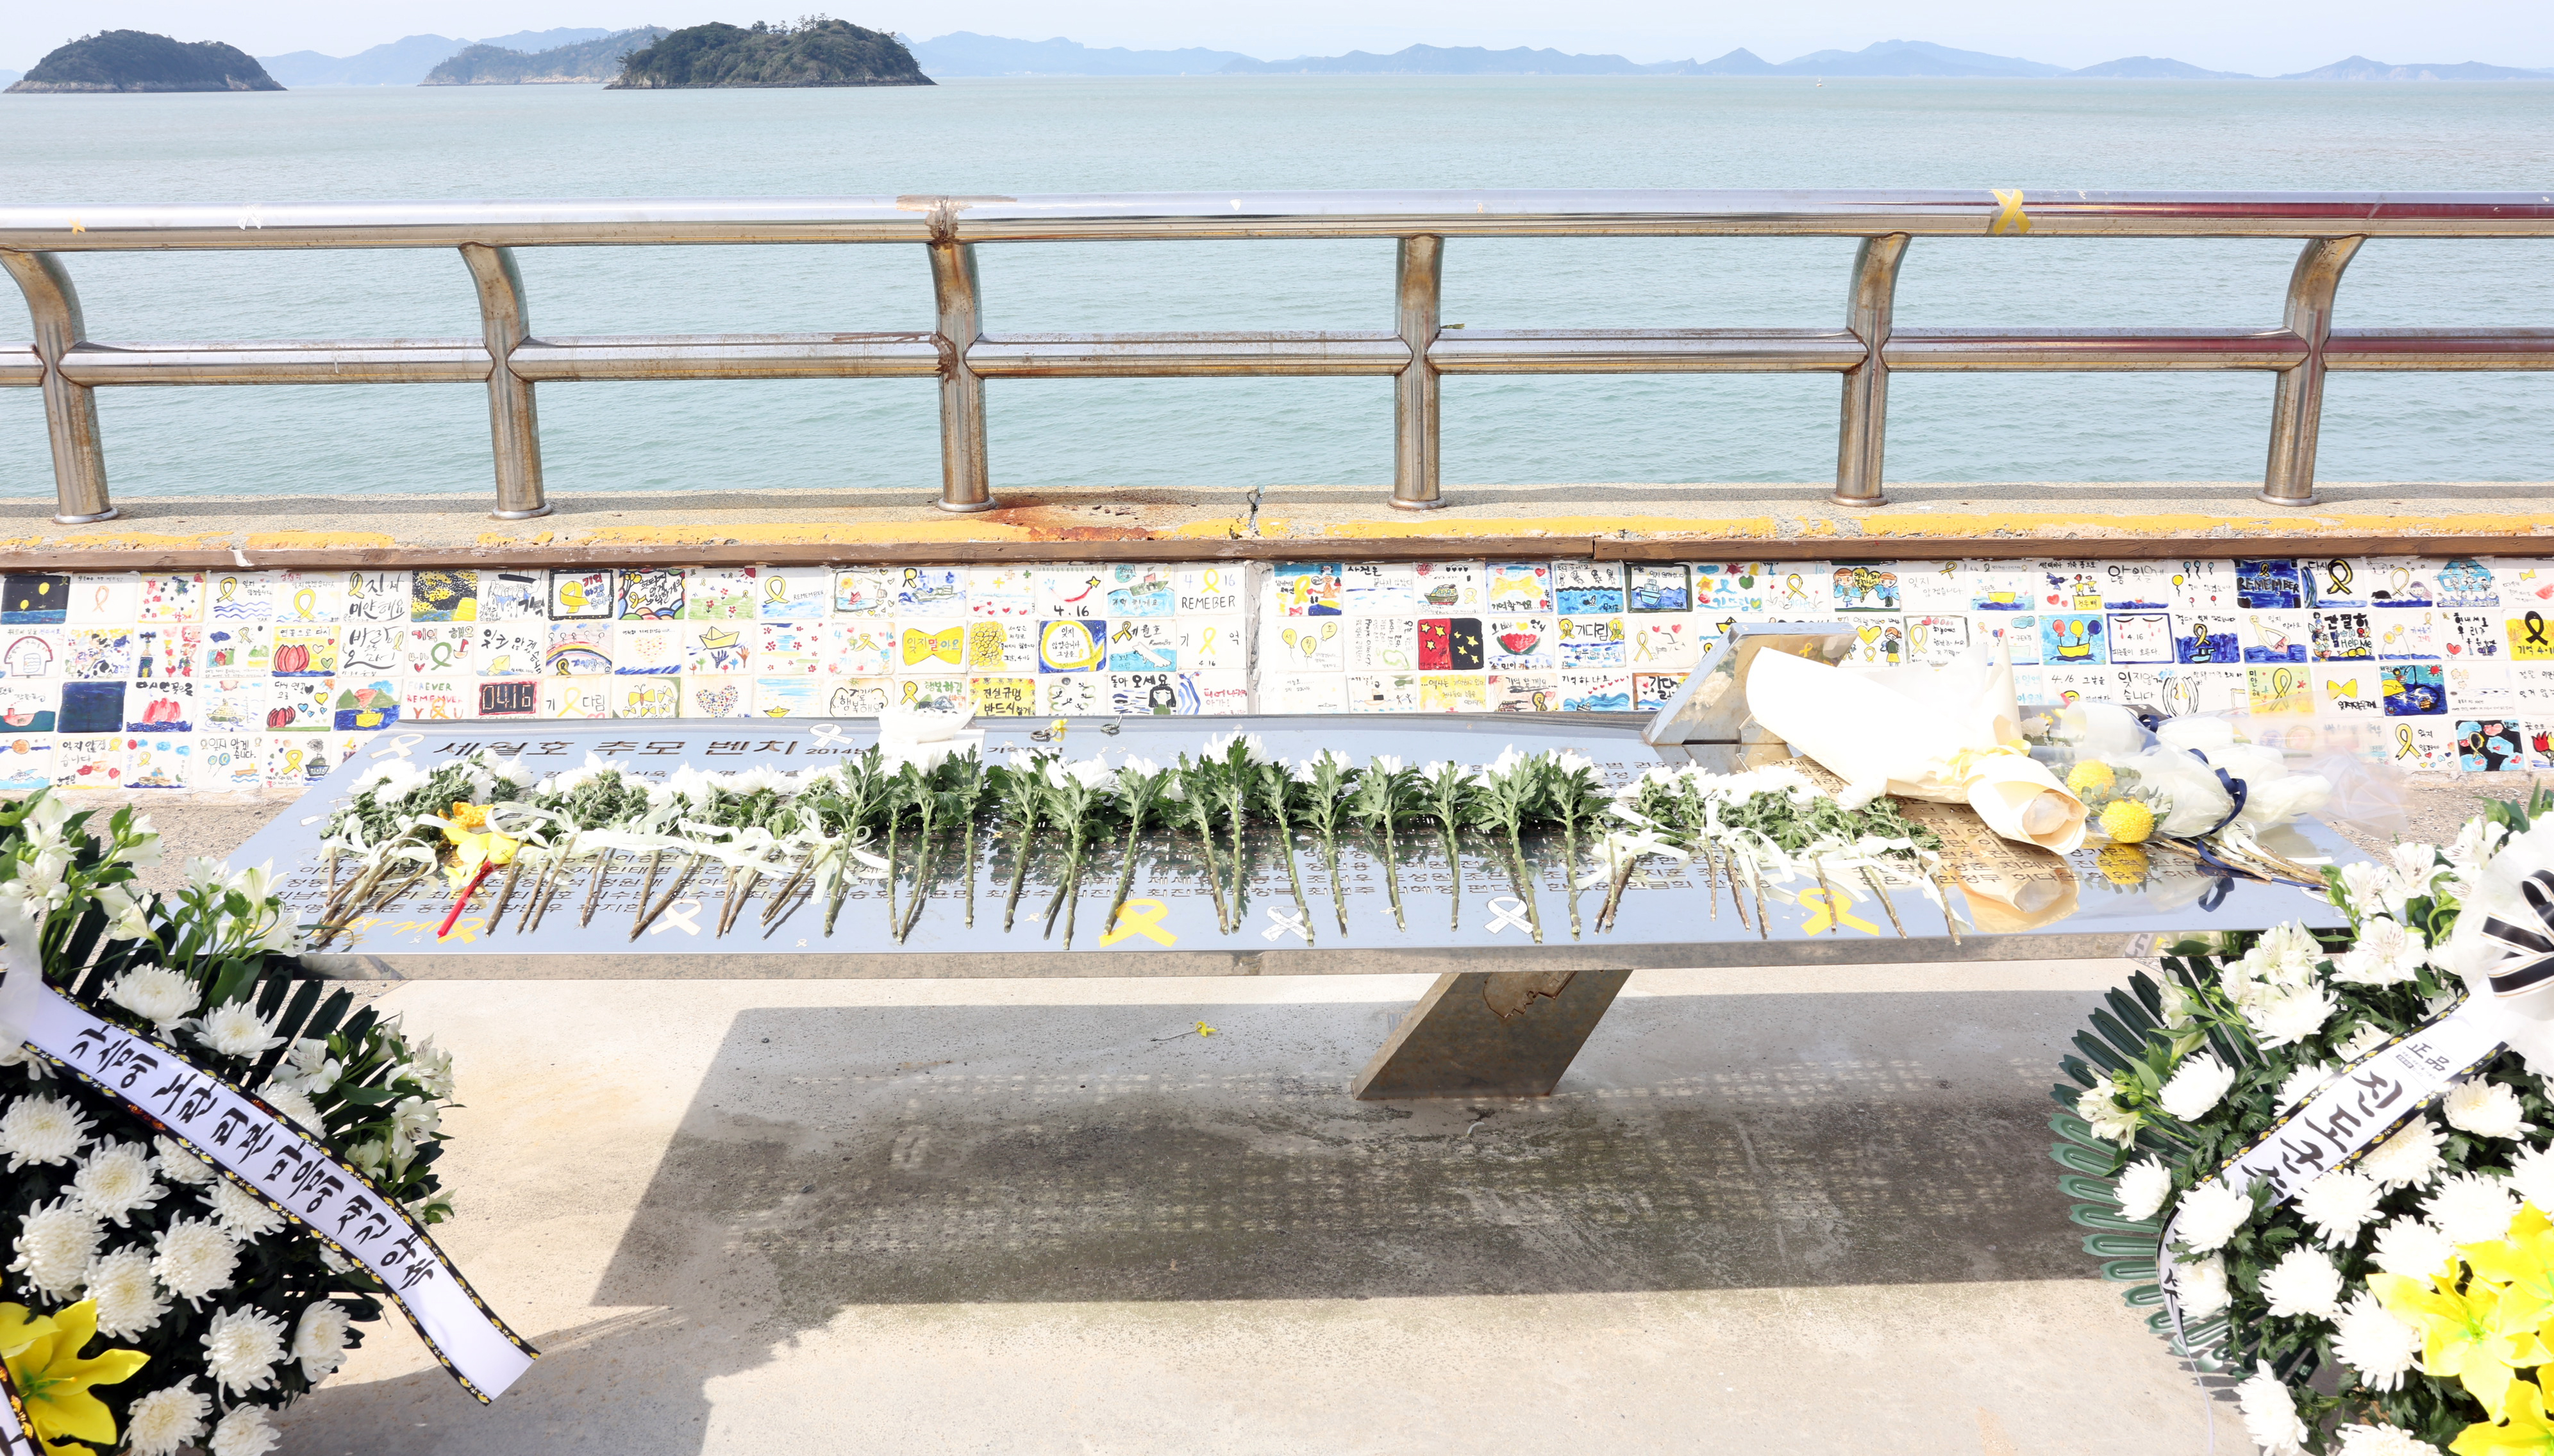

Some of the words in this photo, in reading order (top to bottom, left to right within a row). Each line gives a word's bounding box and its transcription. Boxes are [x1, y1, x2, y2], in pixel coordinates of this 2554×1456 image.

[583, 573, 603, 587] 기억
[1185, 574, 1193, 588] 4
[1908, 577, 1929, 588] 잊지
[2237, 577, 2300, 593] REMEMBER
[1181, 595, 1235, 610] REMEBER
[1053, 604, 1089, 617] 4.16
[2267, 615, 2282, 624] 잊지
[280, 629, 312, 638] 연꽃으로
[412, 628, 438, 642] 기억
[834, 630, 842, 640] 4
[886, 631, 894, 640] 16
[1061, 626, 1074, 638] 잊지
[1574, 622, 1608, 641] 기다림
[1180, 633, 1189, 647] 기
[1229, 630, 1239, 643] 억
[1306, 638, 1312, 649] 월
[2341, 640, 2358, 649] Help
[2360, 640, 2371, 649] Me
[2112, 648, 2133, 656] 피눈물이
[2517, 645, 2533, 655] 기억
[274, 681, 288, 689] 다시
[1506, 677, 1520, 686] 기억
[2051, 674, 2074, 684] 4.16
[2082, 676, 2105, 685] 그날을
[2249, 670, 2260, 697] 미안해
[408, 682, 453, 691] FOREVER
[983, 686, 1021, 701] 진실규명
[582, 694, 605, 712] 다림
[2417, 729, 2433, 738] 잊지
[62, 741, 83, 752] 잊지
[208, 738, 227, 751] 잊지
[433, 741, 574, 756] 세월호
[593, 741, 687, 756] 추모
[705, 740, 799, 756] 벤치
[2404, 1041, 2448, 1073] 正品
[70, 1024, 158, 1091] 가슴에
[150, 1071, 220, 1125] 노란
[213, 1110, 275, 1166] 리본
[262, 1143, 344, 1215] 마음에
[336, 1193, 393, 1247] 새긴
[379, 1231, 437, 1292] 약속
